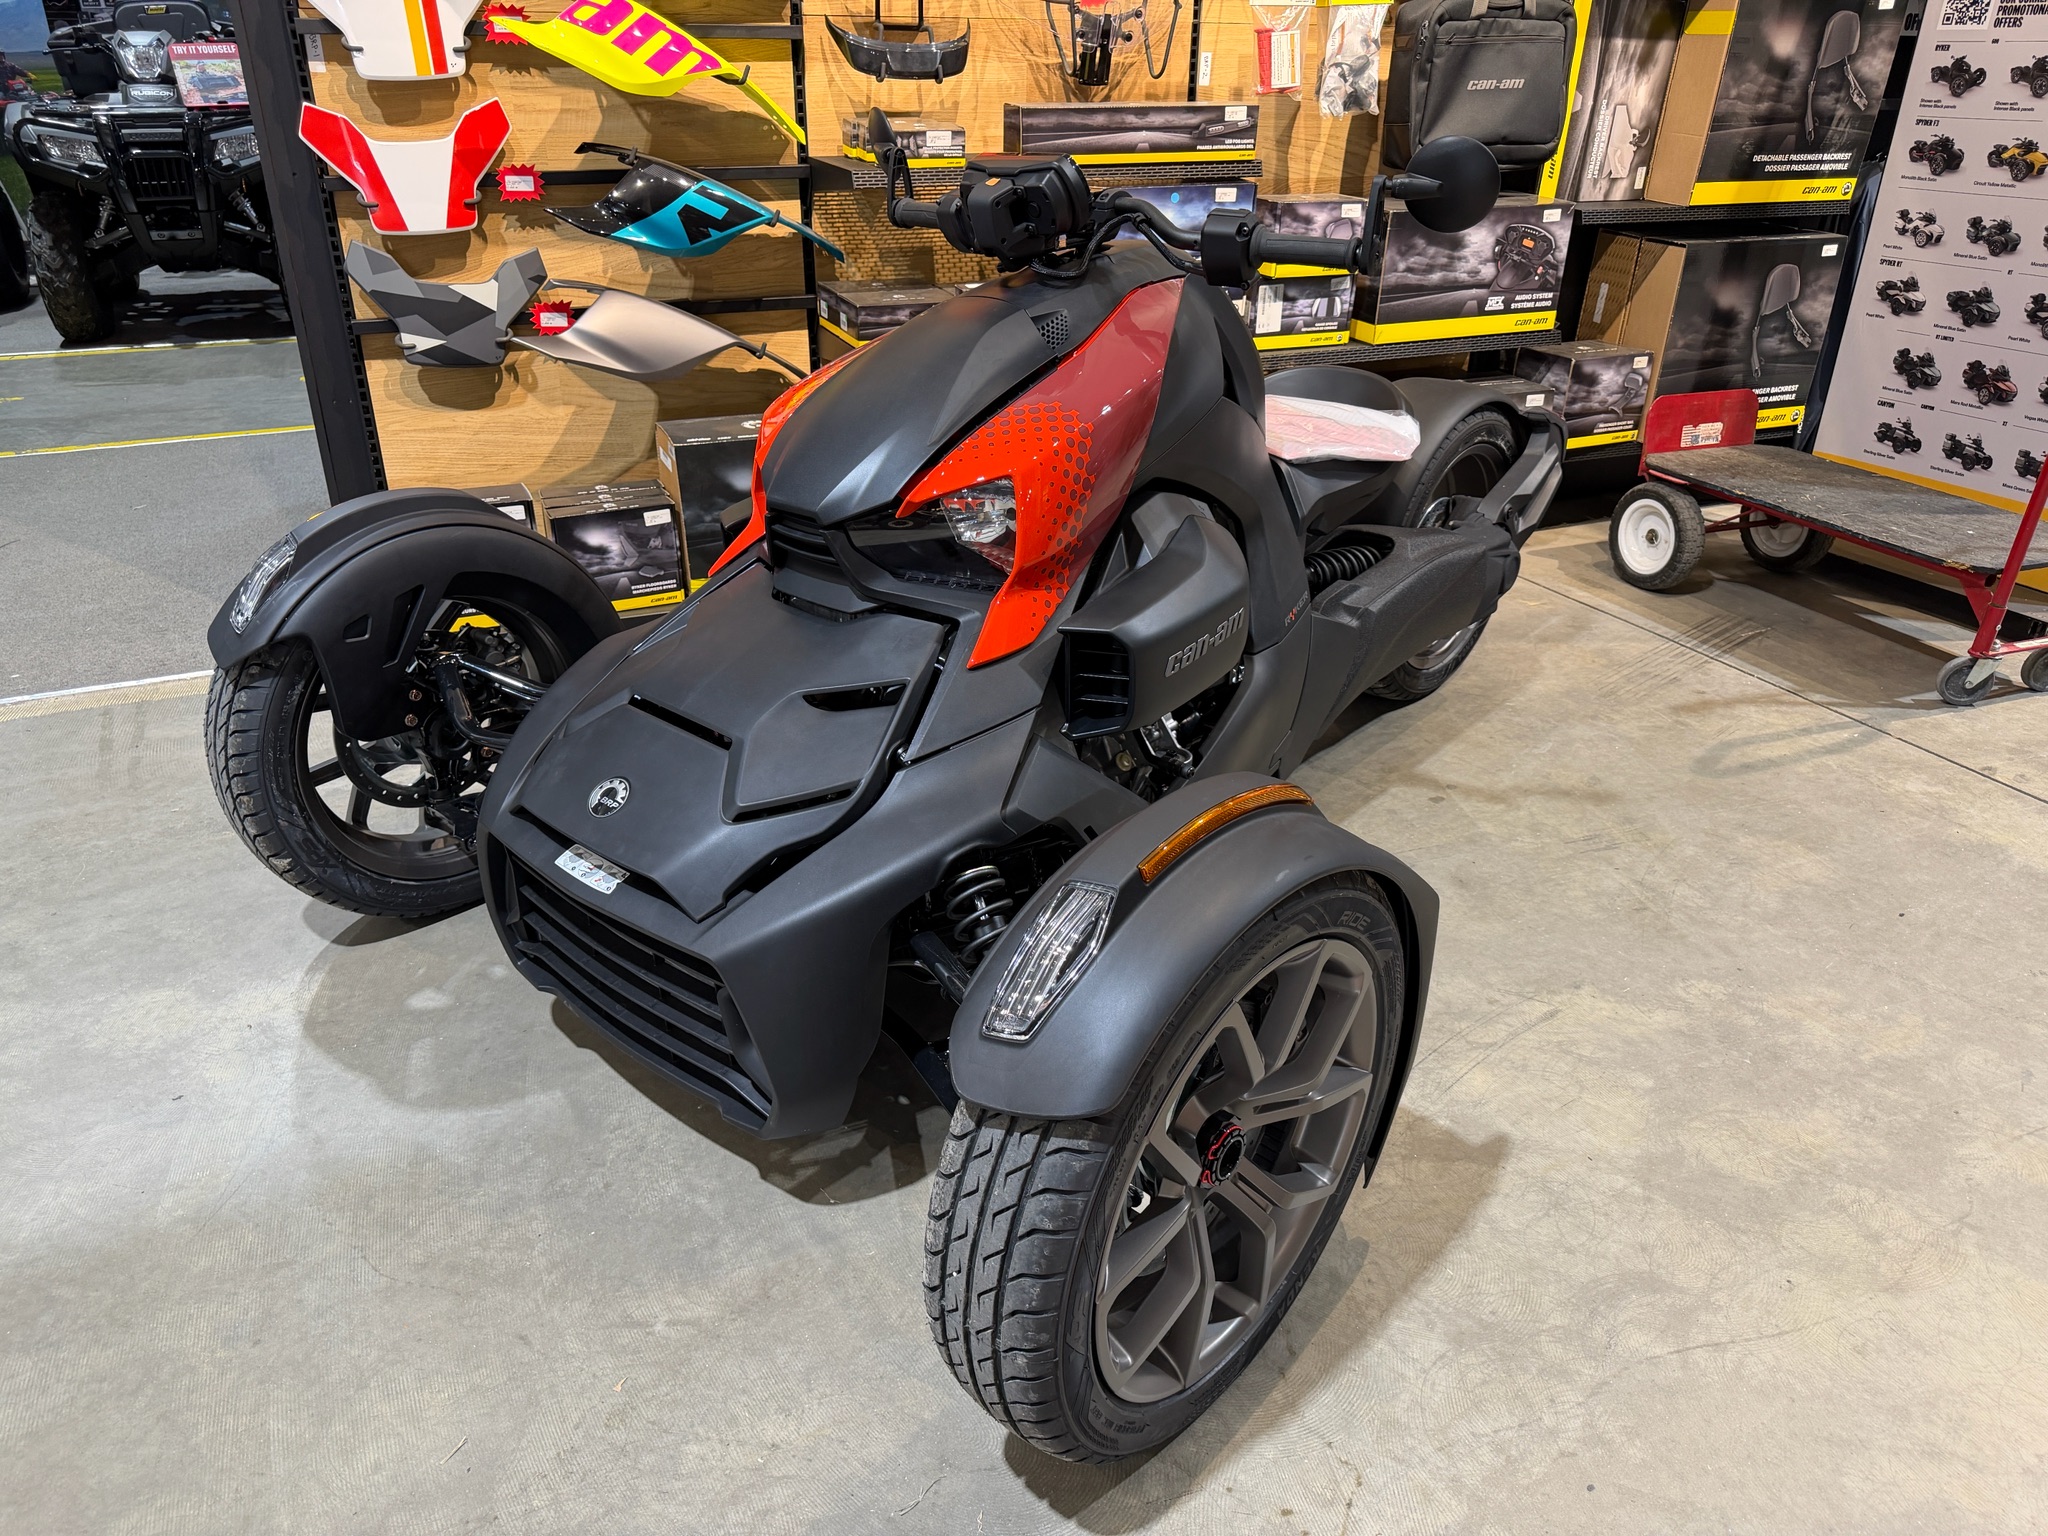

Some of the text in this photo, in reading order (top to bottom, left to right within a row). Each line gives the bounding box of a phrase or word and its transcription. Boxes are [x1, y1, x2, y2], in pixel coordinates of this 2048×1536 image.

[1994, 17, 2024, 28] OFFERS
[172, 44, 236, 54] TRY IT YOURSELF
[1934, 44, 1950, 52] RYKER
[1466, 78, 1525, 90] can-am
[1915, 118, 1932, 126] SPYDER
[1586, 100, 1608, 178] DOSSIER CONDUCTEUR
[1593, 116, 1610, 178] DRIVER BACKREST
[1752, 154, 1789, 162] DETACHABLE
[1789, 153, 1822, 161] PASSENGER
[1764, 164, 1790, 172] DOSSIER
[1802, 186, 1837, 195] can-am
[1880, 258, 1903, 268] SPYDER RT
[1533, 292, 1553, 300] SYSTEM
[1514, 318, 1548, 326] can-am
[1770, 384, 1799, 393] BACKREST
[1769, 393, 1796, 402] AMOVIBLE
[1877, 400, 1895, 409] CANYON
[1921, 403, 1935, 411] CANYON
[1930, 465, 1944, 473] Sterling
[2002, 482, 2013, 490] Moss
[646, 579, 676, 588] FLOORBOARDS
[632, 586, 663, 594] MARCHEPIEDS
[651, 595, 678, 603] can-am
[1164, 606, 1245, 678] can-am
[600, 796, 620, 808] BRP
